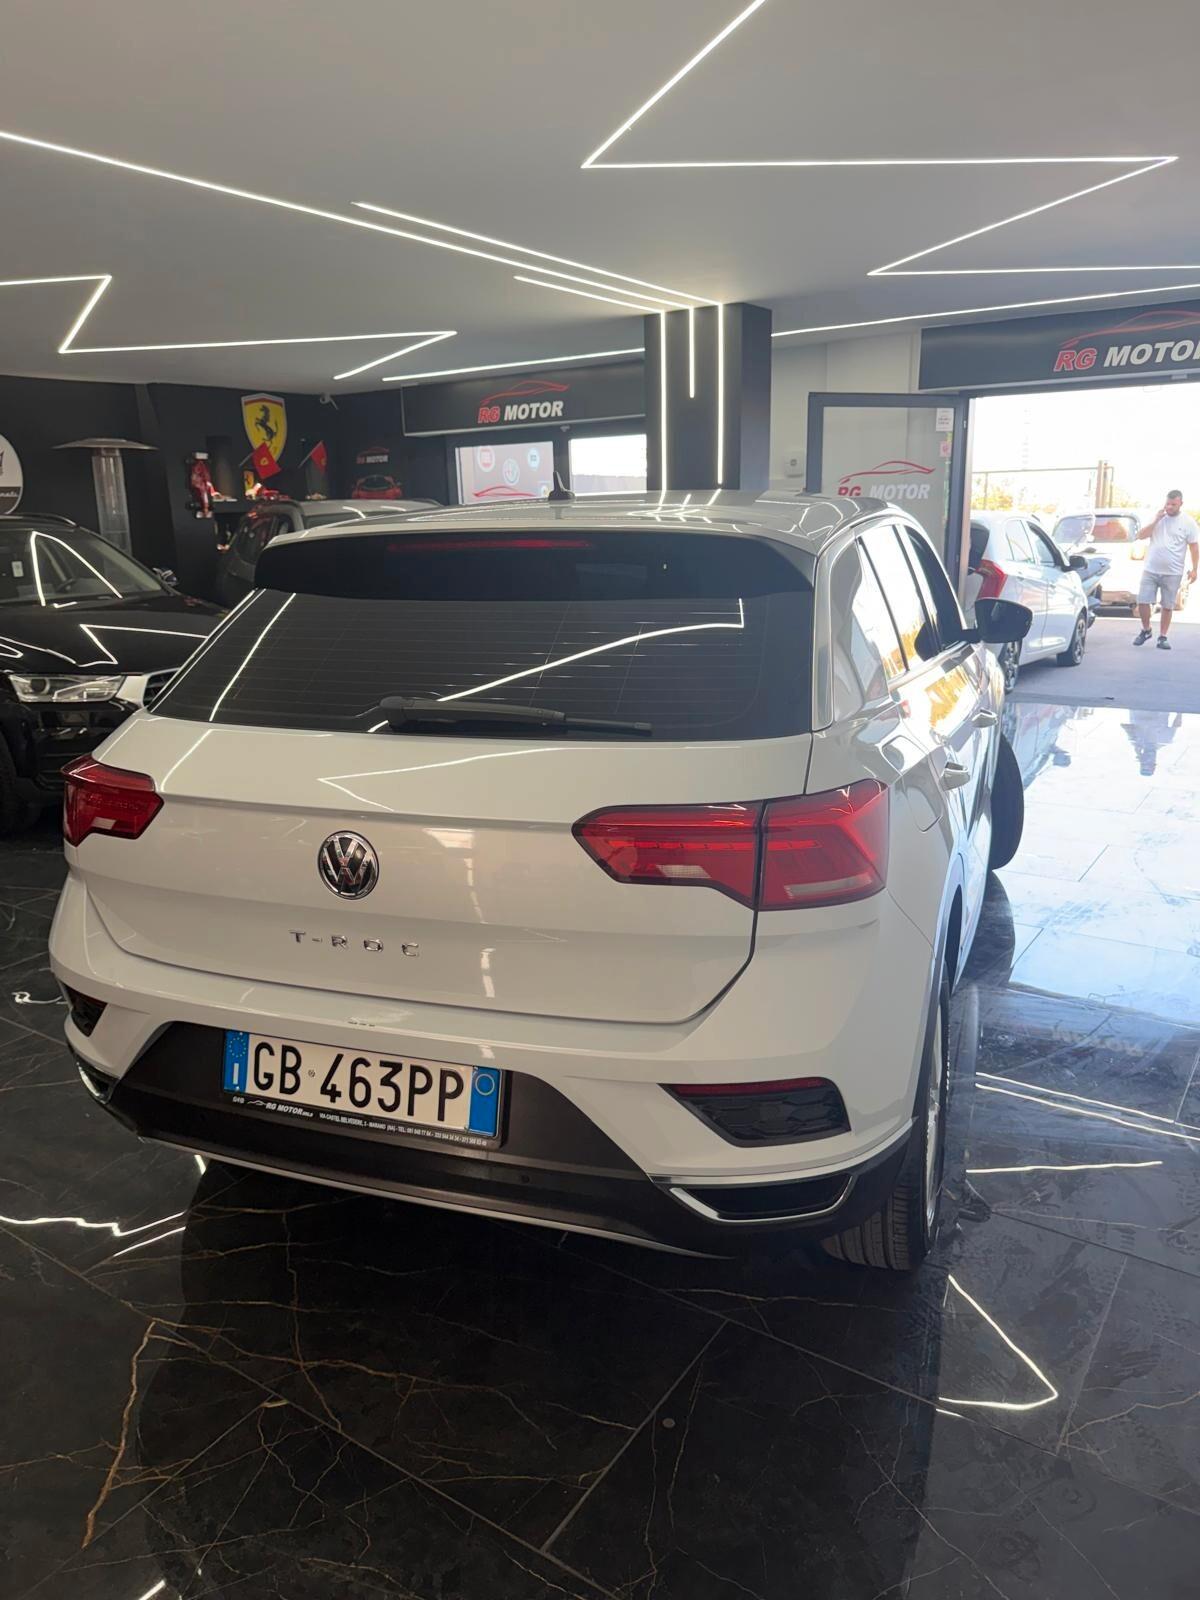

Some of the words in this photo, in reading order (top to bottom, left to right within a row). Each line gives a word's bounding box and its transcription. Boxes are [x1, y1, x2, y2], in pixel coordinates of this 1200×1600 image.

[1053, 348, 1097, 372] RG
[1103, 340, 1200, 367] MOTO
[478, 406, 501, 423] RG
[504, 401, 564, 421] MOTOR
[869, 484, 931, 500] MOTOR
[289, 929, 420, 957] T-ROC
[253, 1041, 302, 1096] GB
[319, 1053, 465, 1122] 463PP
[265, 1102, 277, 1110] RG
[277, 1104, 304, 1116] MOTOR
